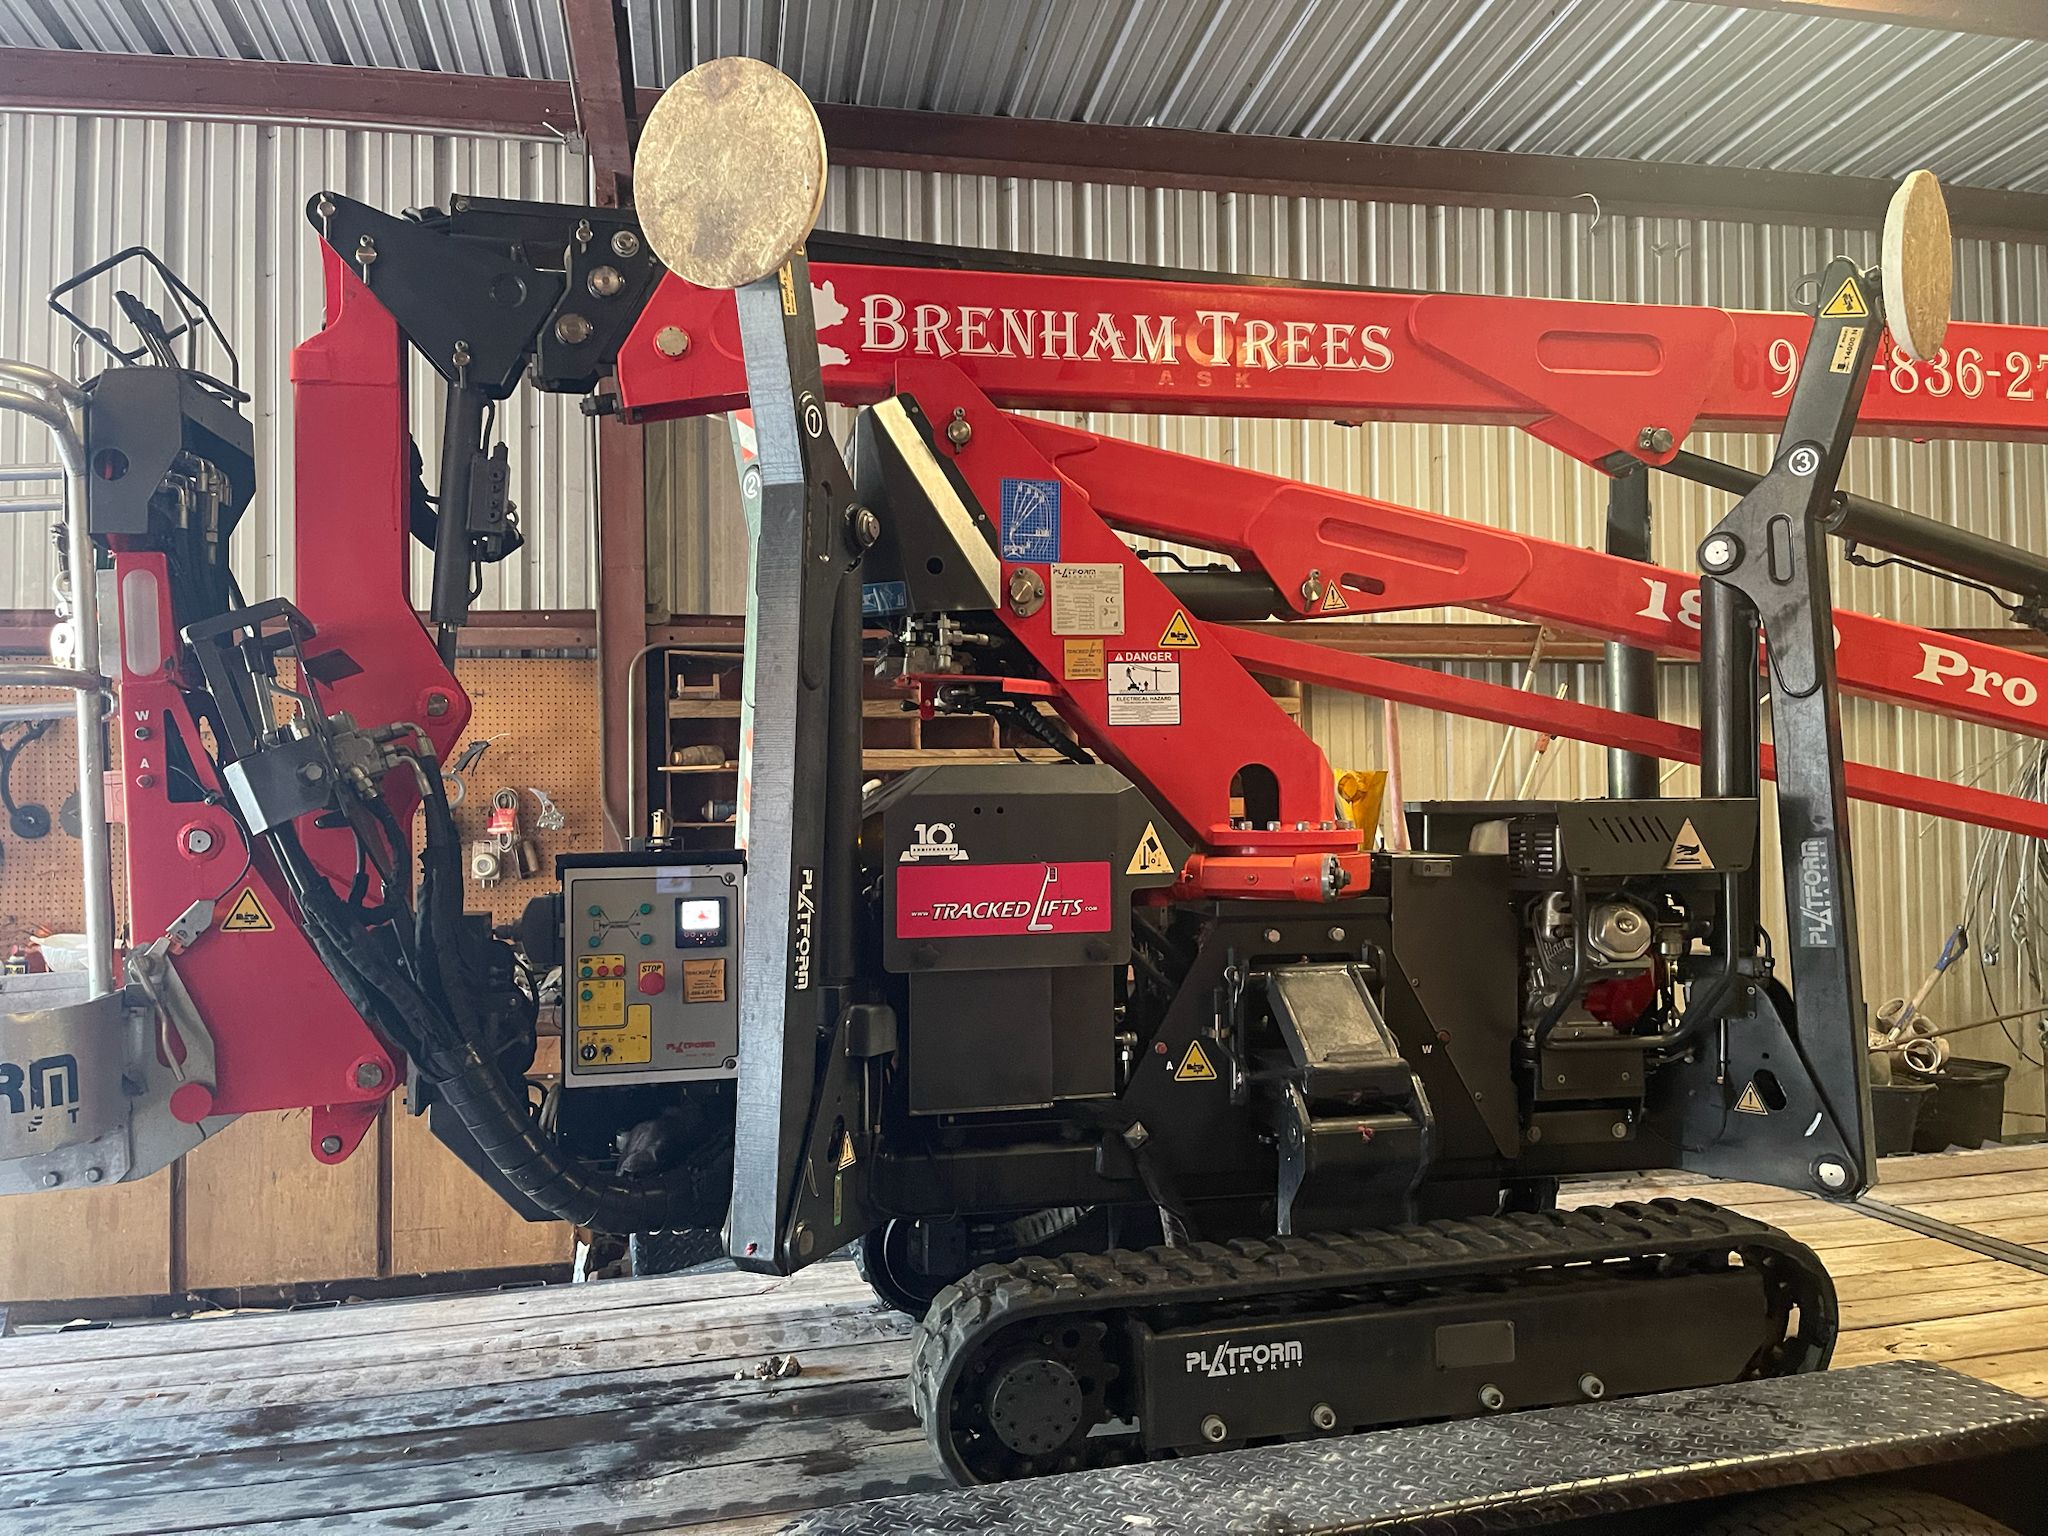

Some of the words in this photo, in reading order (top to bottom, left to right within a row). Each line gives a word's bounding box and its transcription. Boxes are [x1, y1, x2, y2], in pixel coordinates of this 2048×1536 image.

[859, 293, 1180, 366] BRENHAM
[1195, 309, 1395, 374] TREES
[1125, 652, 1173, 662] DANGER
[1912, 642, 2039, 708] Pro
[134, 710, 150, 721] W
[140, 758, 150, 769] A
[1818, 840, 1831, 907] BASKET
[1800, 839, 1833, 945] PLATFORM
[797, 868, 816, 990] PLATFORM
[641, 964, 662, 973] STOP
[1421, 1044, 1433, 1054] W
[1166, 1060, 1174, 1071] A
[1186, 1340, 1303, 1377] PLATFORM
[1229, 1360, 1303, 1376] BASKET
